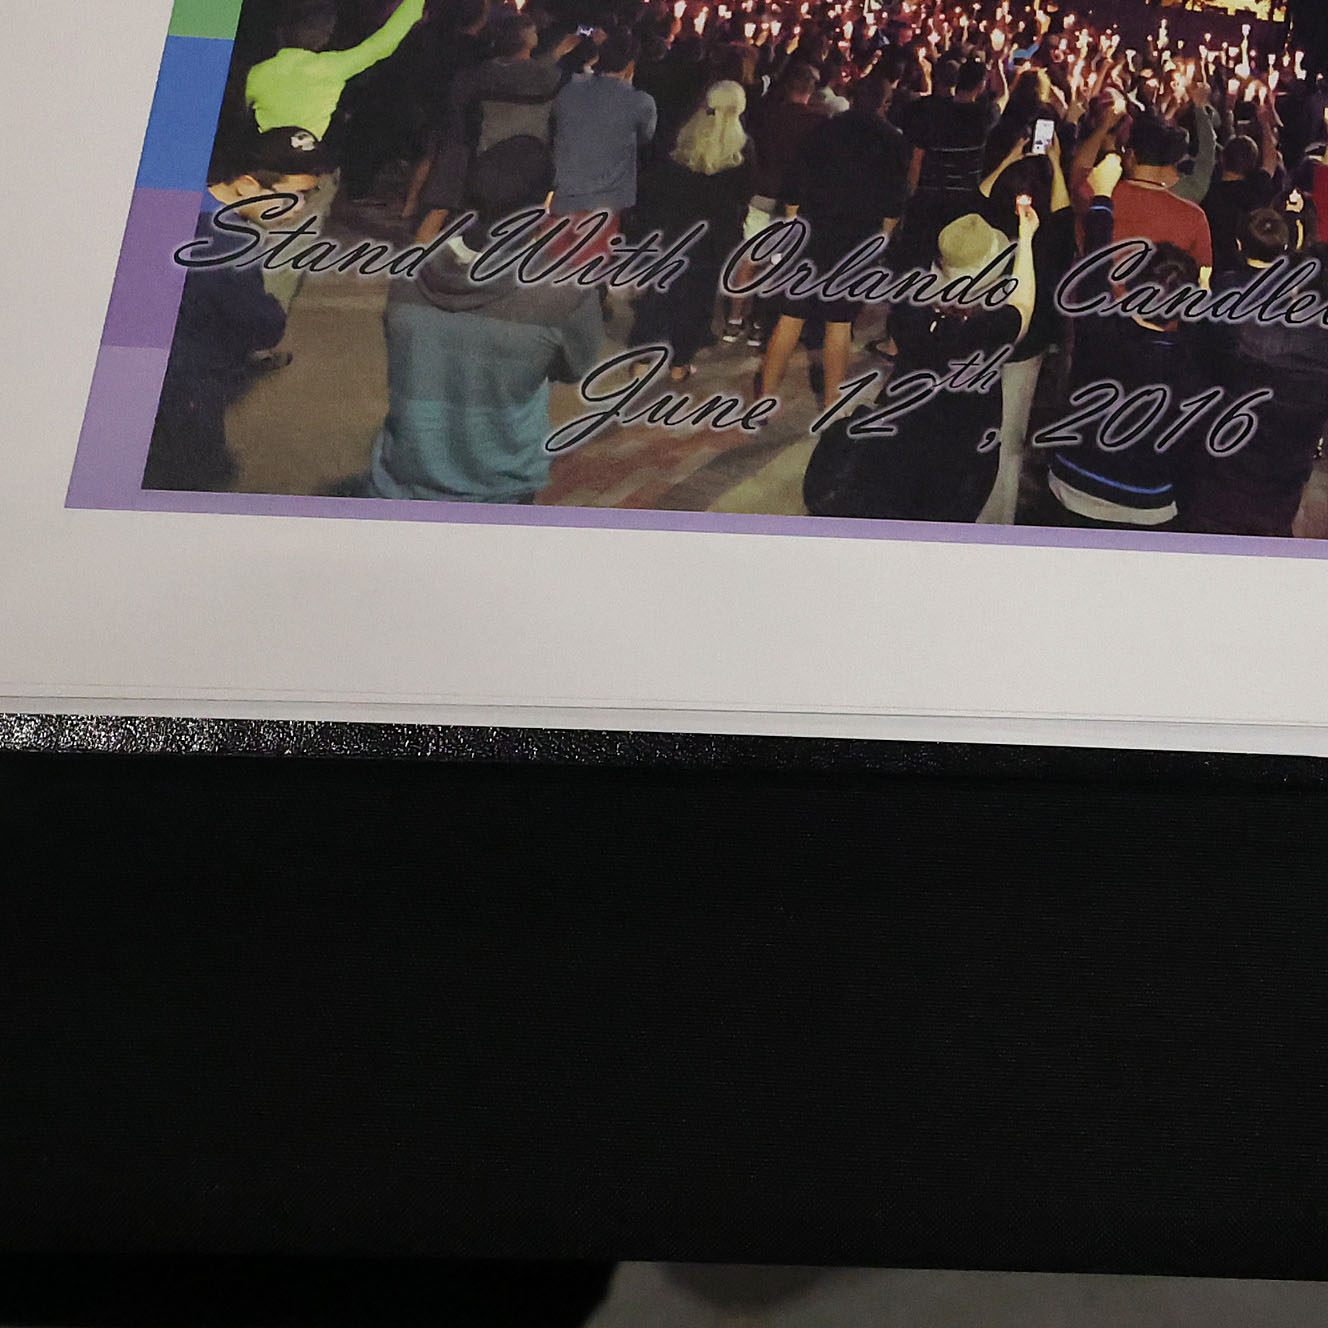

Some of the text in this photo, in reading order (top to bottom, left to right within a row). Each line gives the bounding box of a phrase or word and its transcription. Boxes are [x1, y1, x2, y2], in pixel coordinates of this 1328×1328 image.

[172, 192, 476, 279] Stand
[468, 208, 710, 289] With
[721, 218, 1020, 310] Orlando
[545, 345, 780, 453] June
[1034, 381, 1273, 455] 2016
